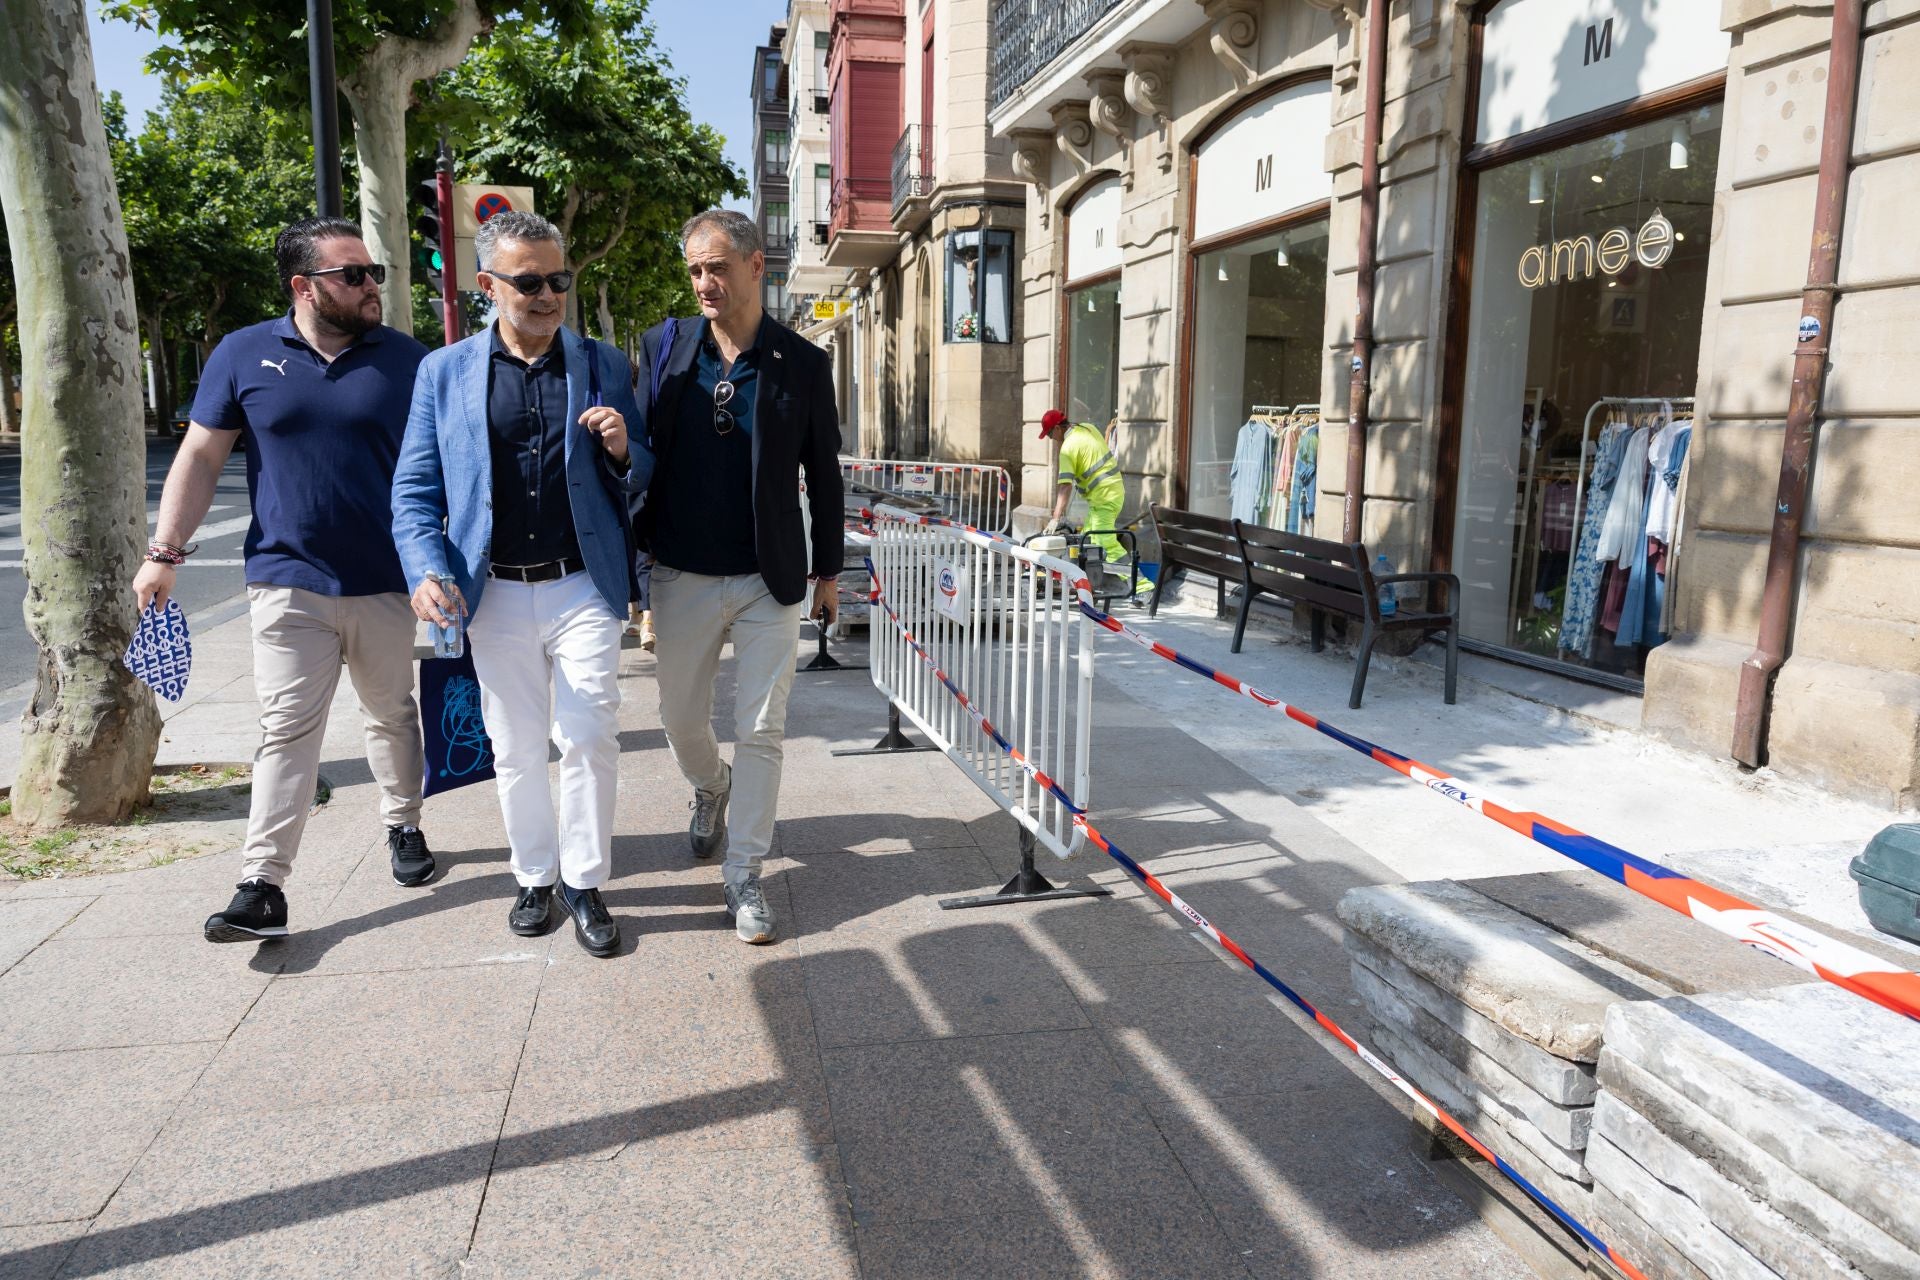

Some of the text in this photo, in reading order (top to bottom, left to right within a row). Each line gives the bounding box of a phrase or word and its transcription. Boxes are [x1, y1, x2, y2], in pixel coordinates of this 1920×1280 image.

[1583, 17, 1614, 67] M
[1255, 153, 1273, 193] M
[1095, 227, 1104, 249] M
[1518, 218, 1670, 288] amee
[815, 303, 834, 312] ORO
